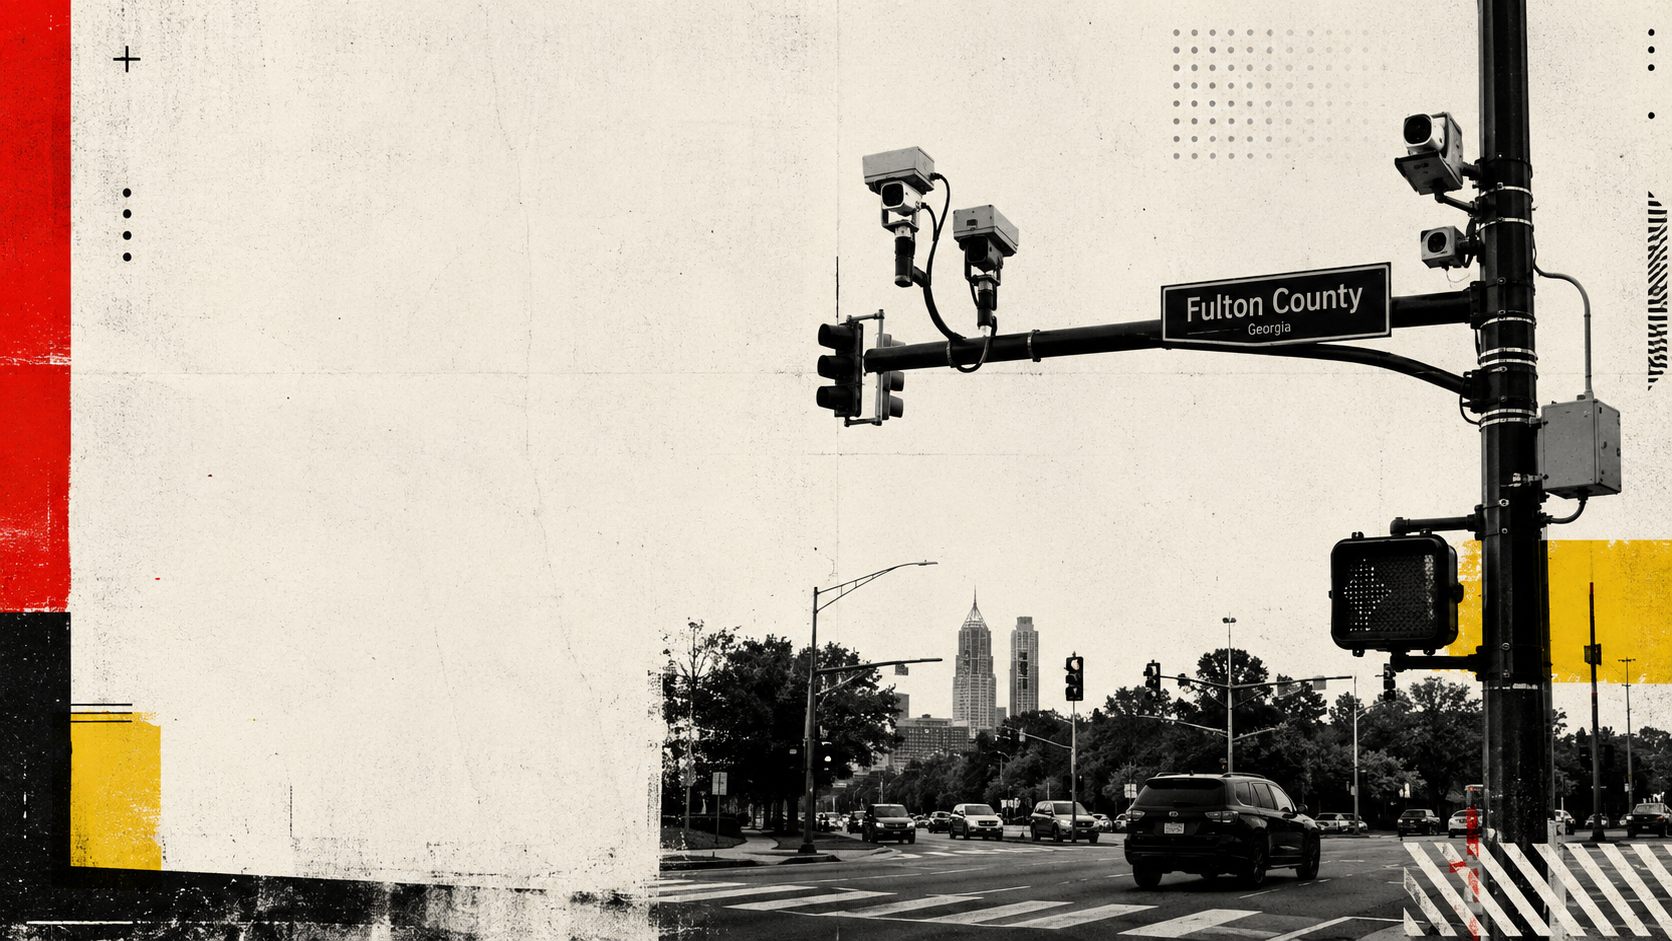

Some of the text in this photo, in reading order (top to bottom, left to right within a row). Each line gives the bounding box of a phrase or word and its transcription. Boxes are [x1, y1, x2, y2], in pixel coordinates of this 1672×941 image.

[1187, 283, 1363, 322] Fulton County
[1247, 321, 1291, 336] Georgia
